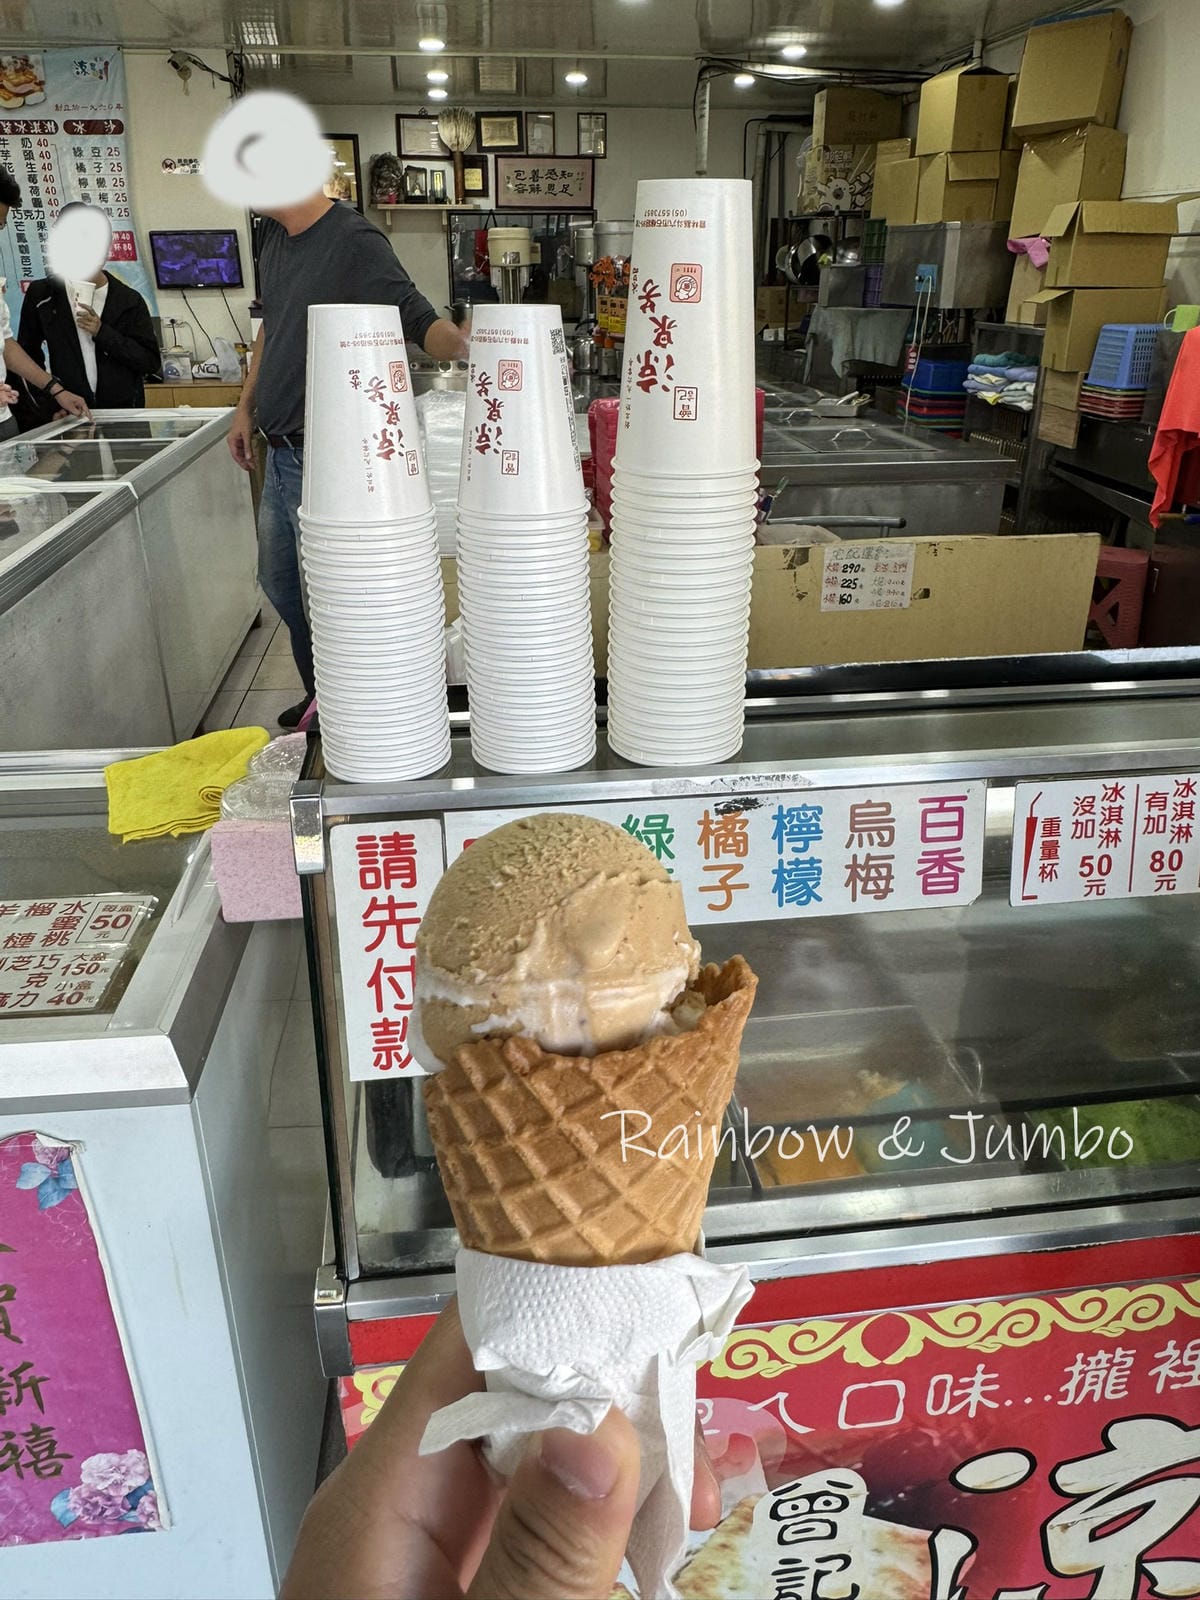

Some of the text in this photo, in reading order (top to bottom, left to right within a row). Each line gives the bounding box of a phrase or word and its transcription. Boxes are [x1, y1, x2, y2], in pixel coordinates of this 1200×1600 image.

[0, 120, 56, 135] 冰淇淋
[37, 138, 49, 148] 40
[107, 147, 121, 157] 25
[0, 149, 51, 161] 芋頭 40
[41, 162, 53, 172] 40
[110, 162, 123, 172] 25
[43, 174, 55, 184] 40
[112, 177, 125, 188] 25
[45, 186, 57, 195] 40
[114, 193, 128, 203] 25
[48, 198, 59, 207] 40
[117, 207, 130, 218] 25
[11, 209, 46, 220] 巧克力
[677, 389, 695, 418] 曾記
[503, 452, 517, 473] 曾記
[1071, 796, 1096, 840] 沒加
[1097, 782, 1126, 849] 冰淇淋
[1142, 791, 1170, 835] 有加
[1169, 778, 1197, 844] 冰淇淋
[621, 813, 675, 874] 綠
[844, 799, 896, 903] 烏梅
[915, 795, 969, 896] 百香
[1038, 816, 1062, 883] 重量杯
[697, 808, 750, 911] 橘子
[771, 803, 824, 908] 檸檬
[1078, 854, 1113, 878] 50
[1149, 849, 1184, 873] 80
[1084, 879, 1106, 897] 元
[1154, 874, 1177, 892] 元
[3, 902, 57, 949] 榴槤
[40, 900, 92, 947] 水蜜桃
[89, 914, 133, 931] 50
[355, 831, 422, 1071] 請先付款
[61, 962, 100, 977] 150
[8, 953, 64, 1009] 巧克力
[46, 991, 86, 1006] 40
[0, 1242, 74, 1480] 新禧
